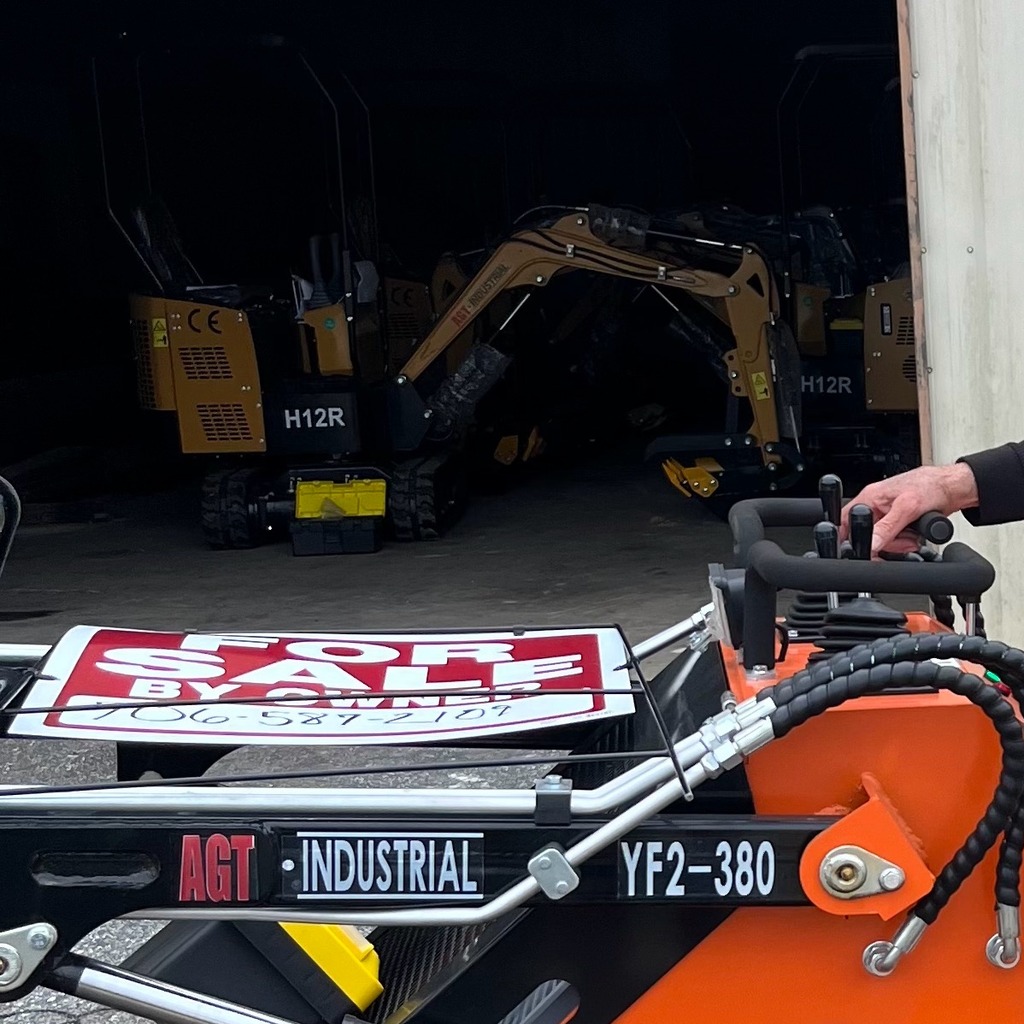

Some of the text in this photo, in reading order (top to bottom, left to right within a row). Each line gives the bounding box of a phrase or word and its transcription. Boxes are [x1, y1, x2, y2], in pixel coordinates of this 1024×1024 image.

[187, 308, 222, 334] CE
[800, 376, 853, 395] H12R
[284, 407, 346, 429] H12R
[179, 633, 515, 666] FOR
[95, 647, 583, 691] SALE
[128, 678, 542, 709] BY OWNER
[179, 833, 478, 902] AGT INDUSTRIAL
[620, 840, 776, 897] YF2-380
